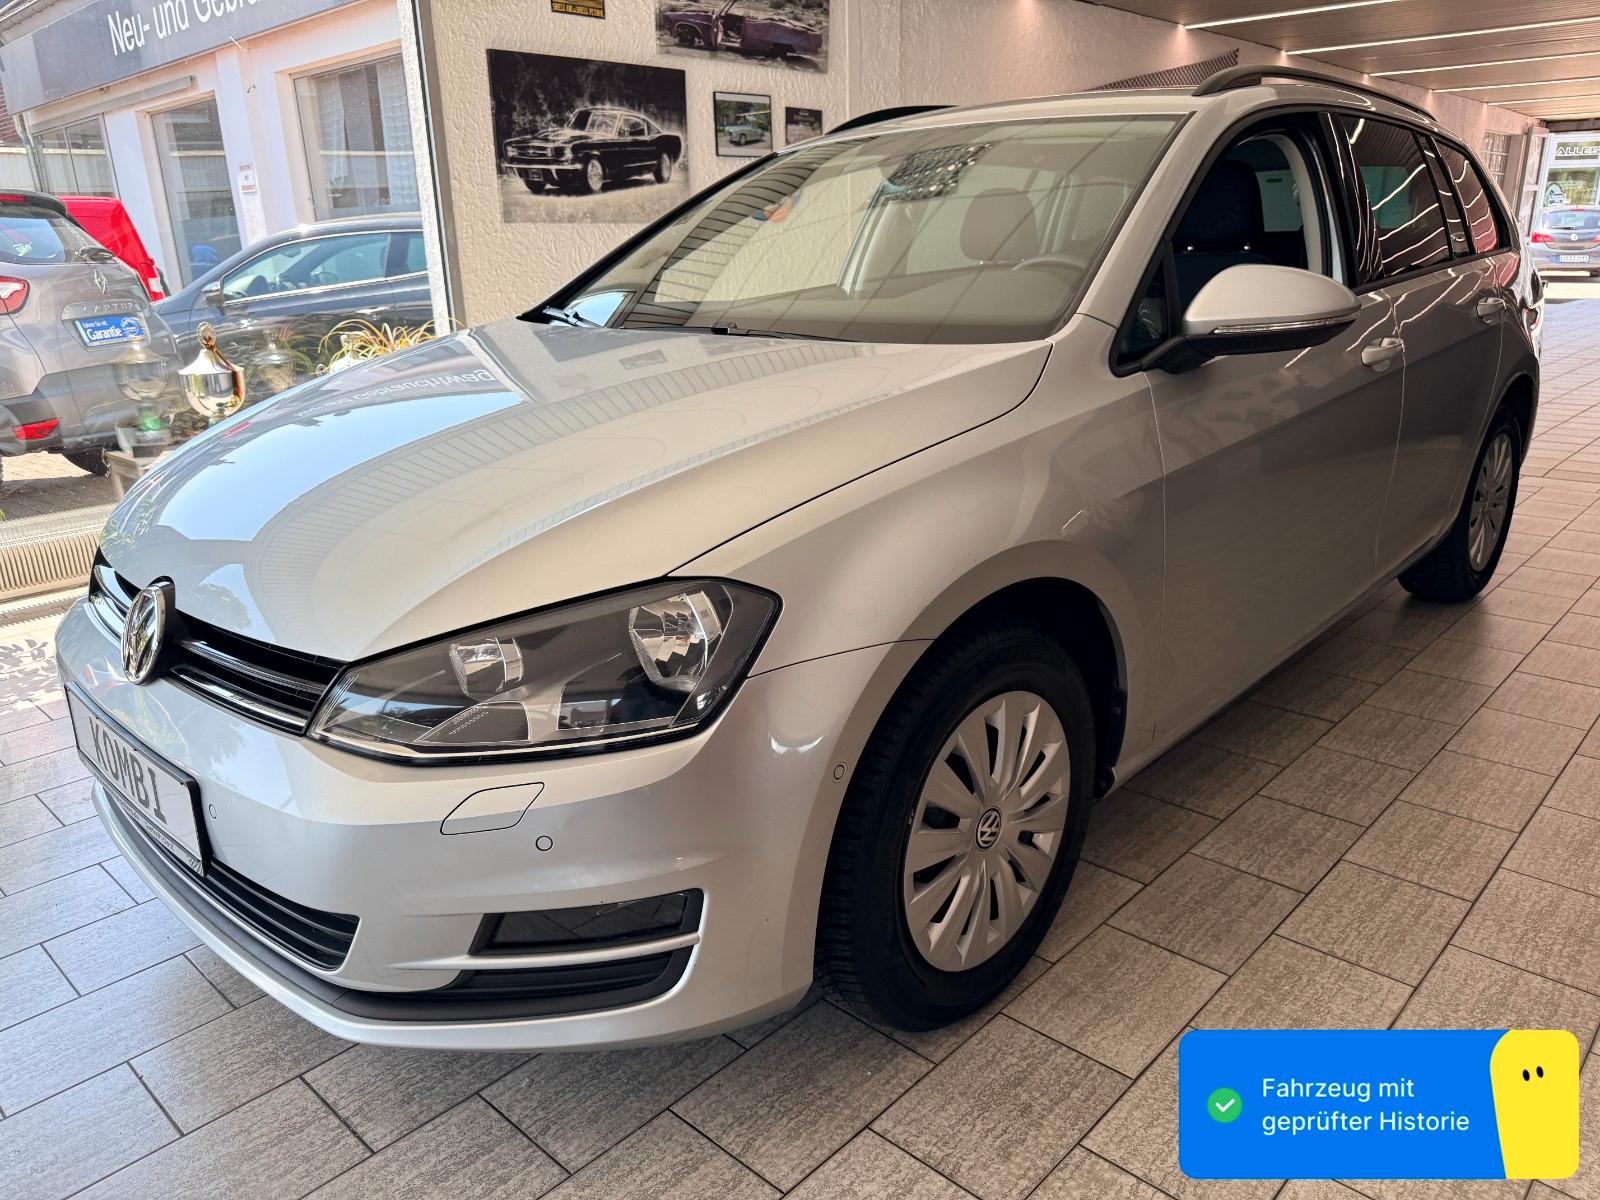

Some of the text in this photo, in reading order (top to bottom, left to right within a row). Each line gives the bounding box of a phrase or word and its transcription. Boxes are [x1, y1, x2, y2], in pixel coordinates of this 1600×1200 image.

[108, 11, 150, 56] Neu-
[152, 0, 190, 39] und
[86, 325, 122, 341] Garantie
[89, 715, 168, 825] KOMBI
